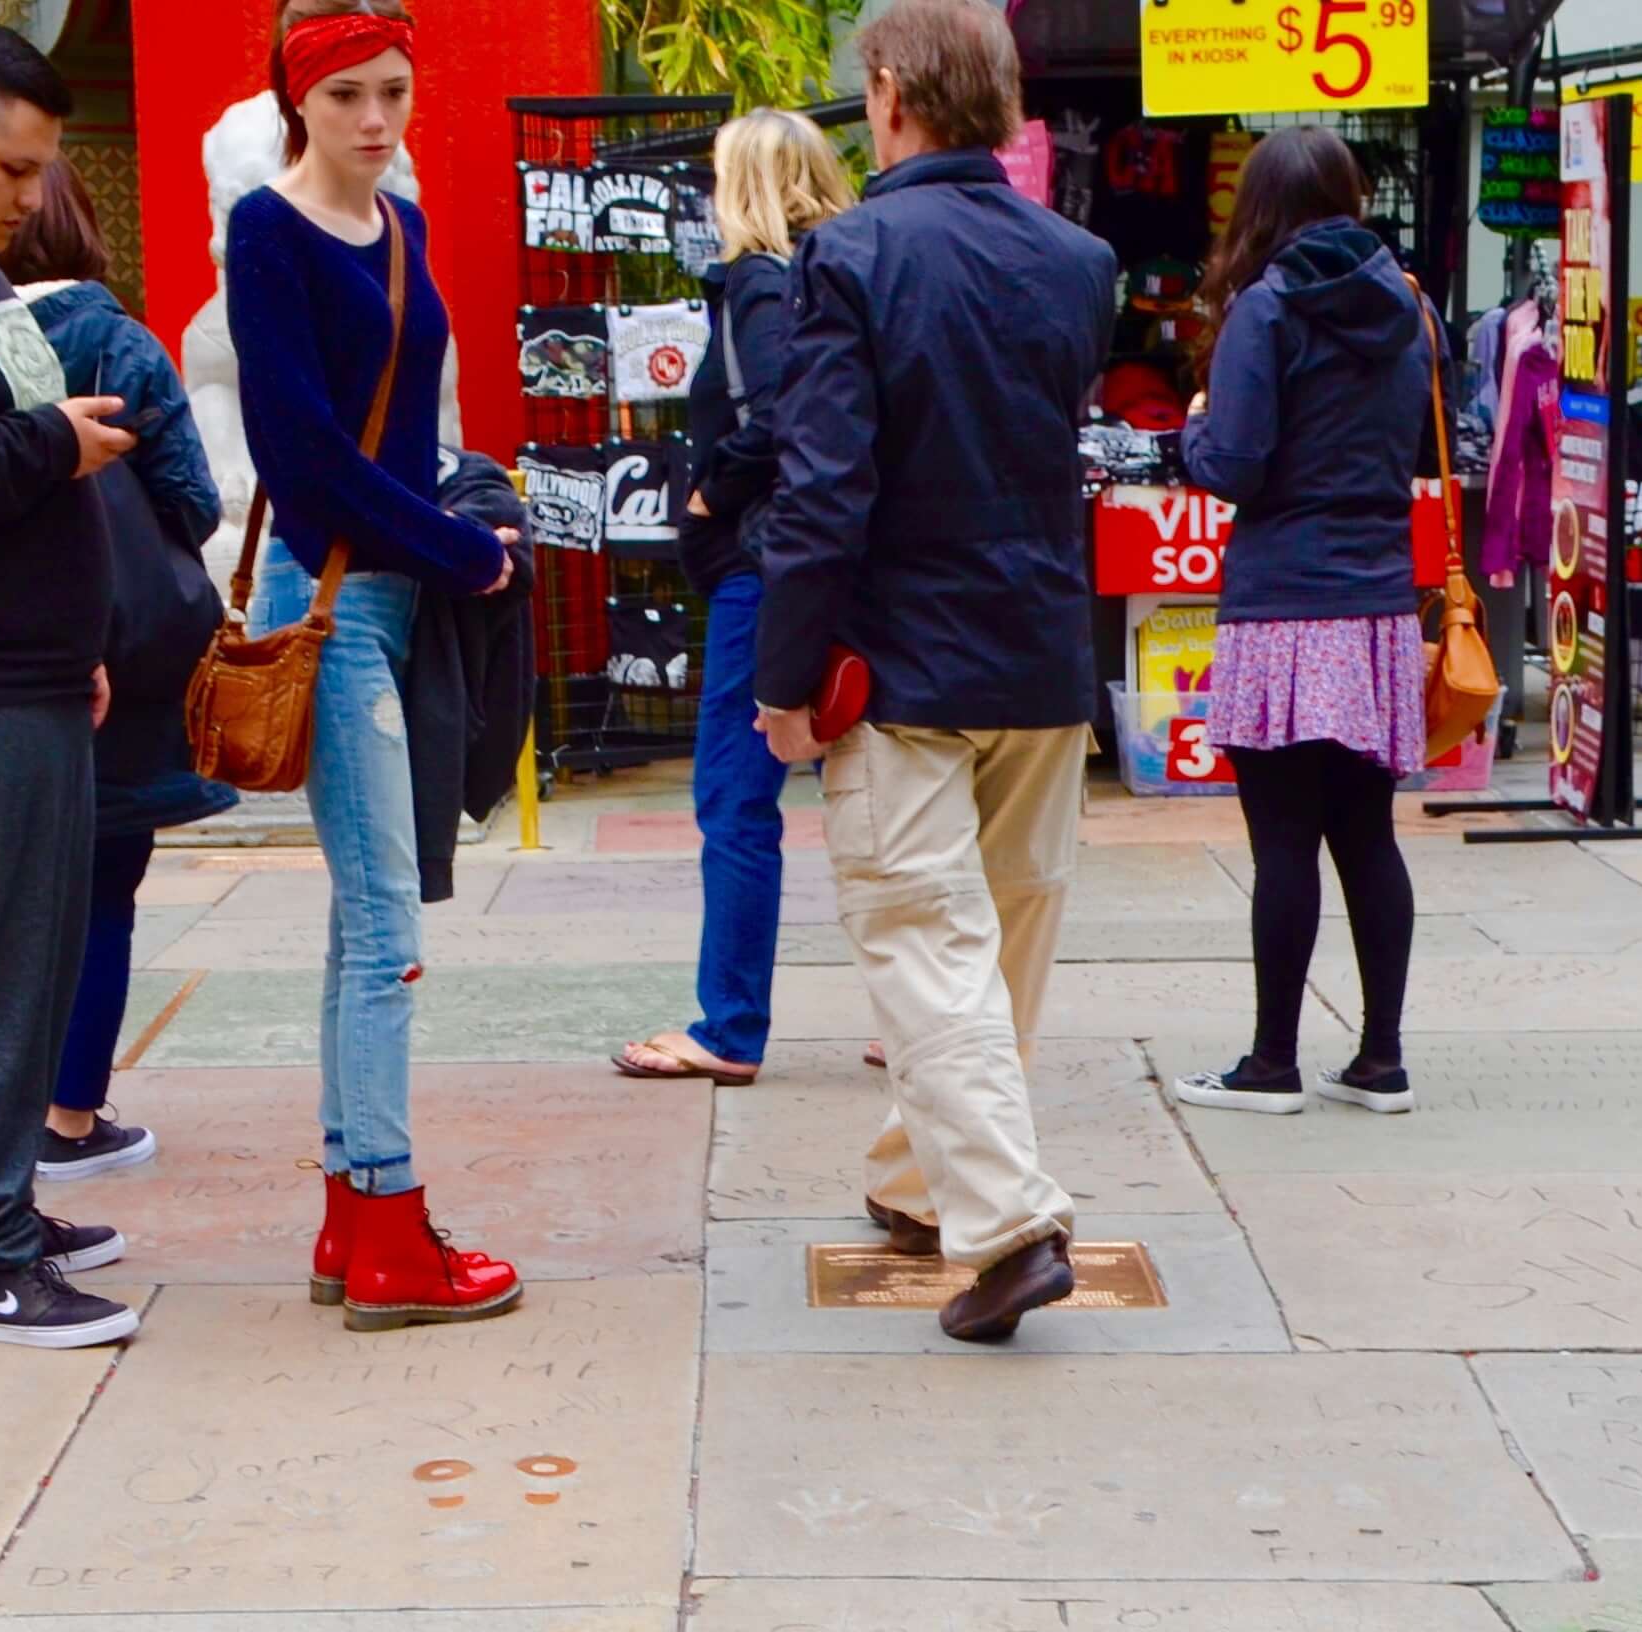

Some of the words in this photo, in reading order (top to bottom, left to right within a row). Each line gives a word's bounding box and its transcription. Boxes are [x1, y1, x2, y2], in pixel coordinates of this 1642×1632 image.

[1149, 26, 1266, 44] EVERYTHING
[1168, 51, 1185, 64] IN
[1192, 49, 1248, 64] KIOSK
[1563, 324, 1596, 380] TOUR
[1152, 547, 1225, 585] SO
